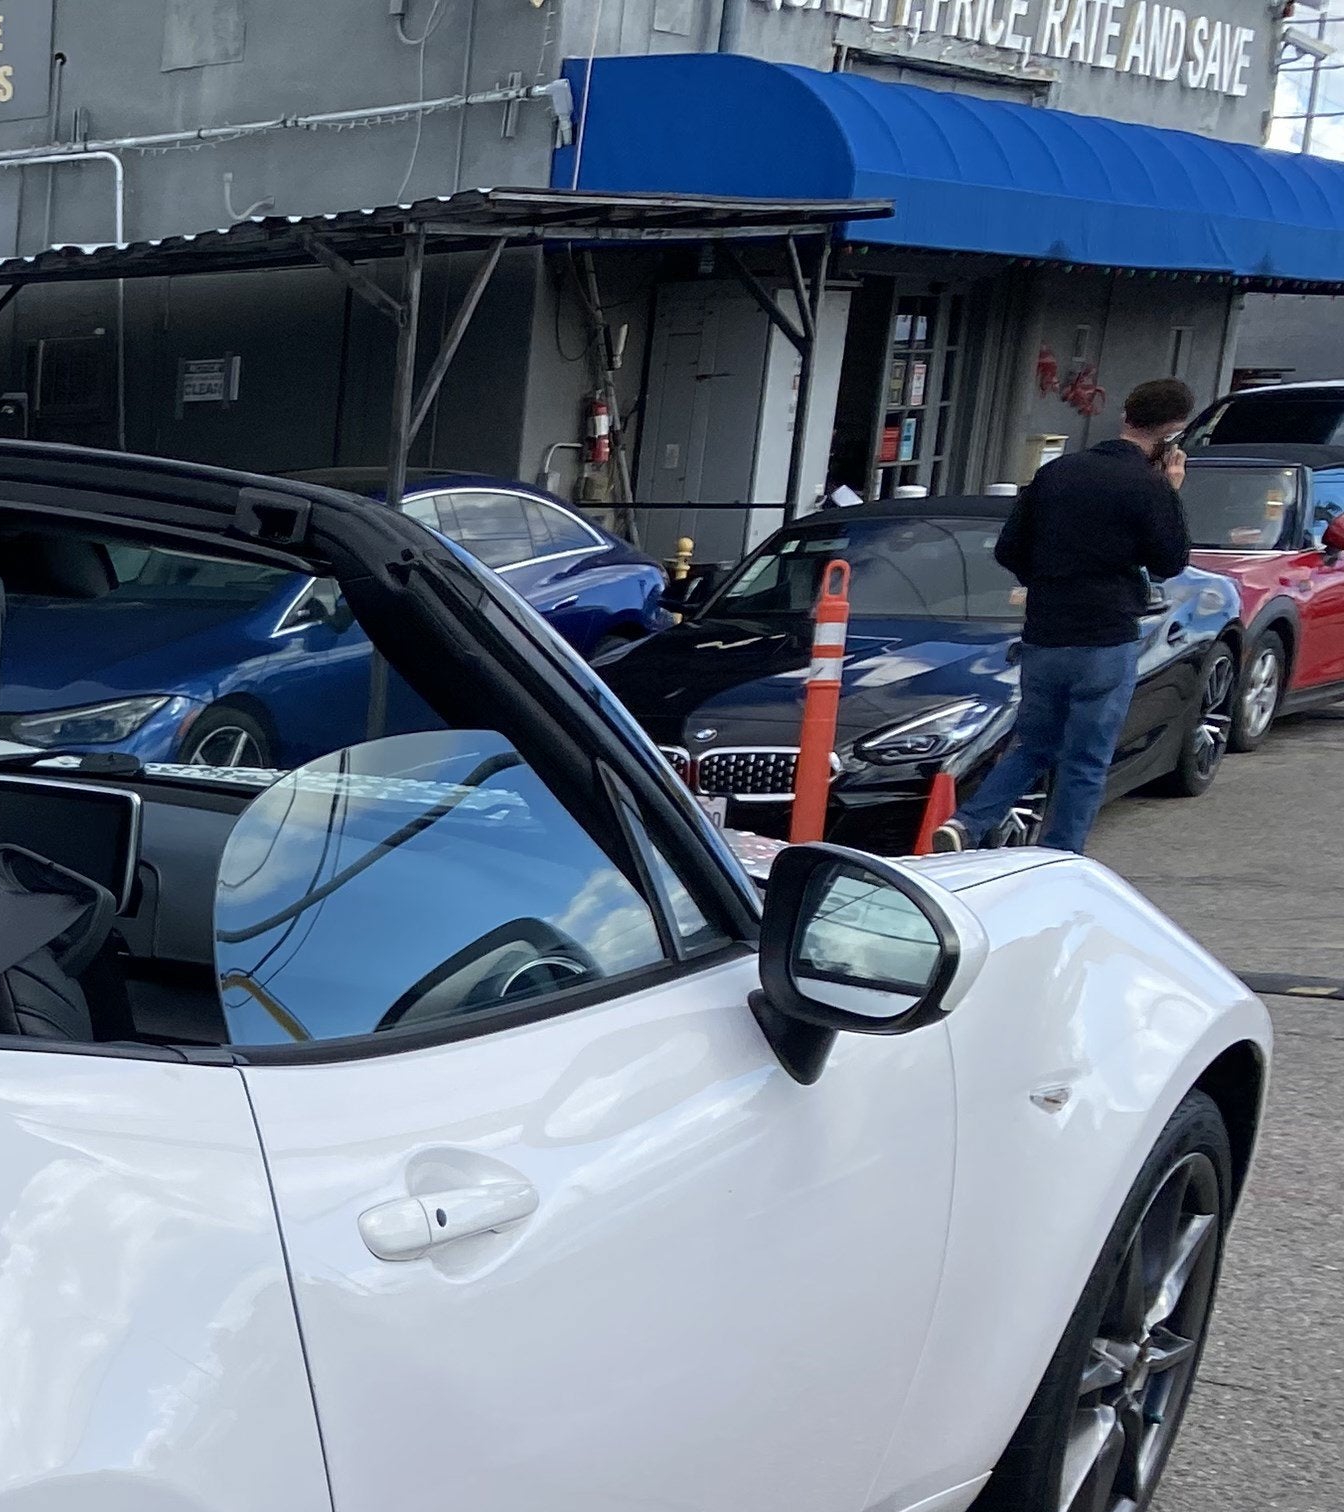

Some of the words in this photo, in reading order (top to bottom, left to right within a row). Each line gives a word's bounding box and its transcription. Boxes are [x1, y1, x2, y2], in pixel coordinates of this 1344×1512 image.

[1037, 0, 1125, 68] RATE
[1115, 1, 1186, 81] AND
[1186, 16, 1255, 96] SAVE
